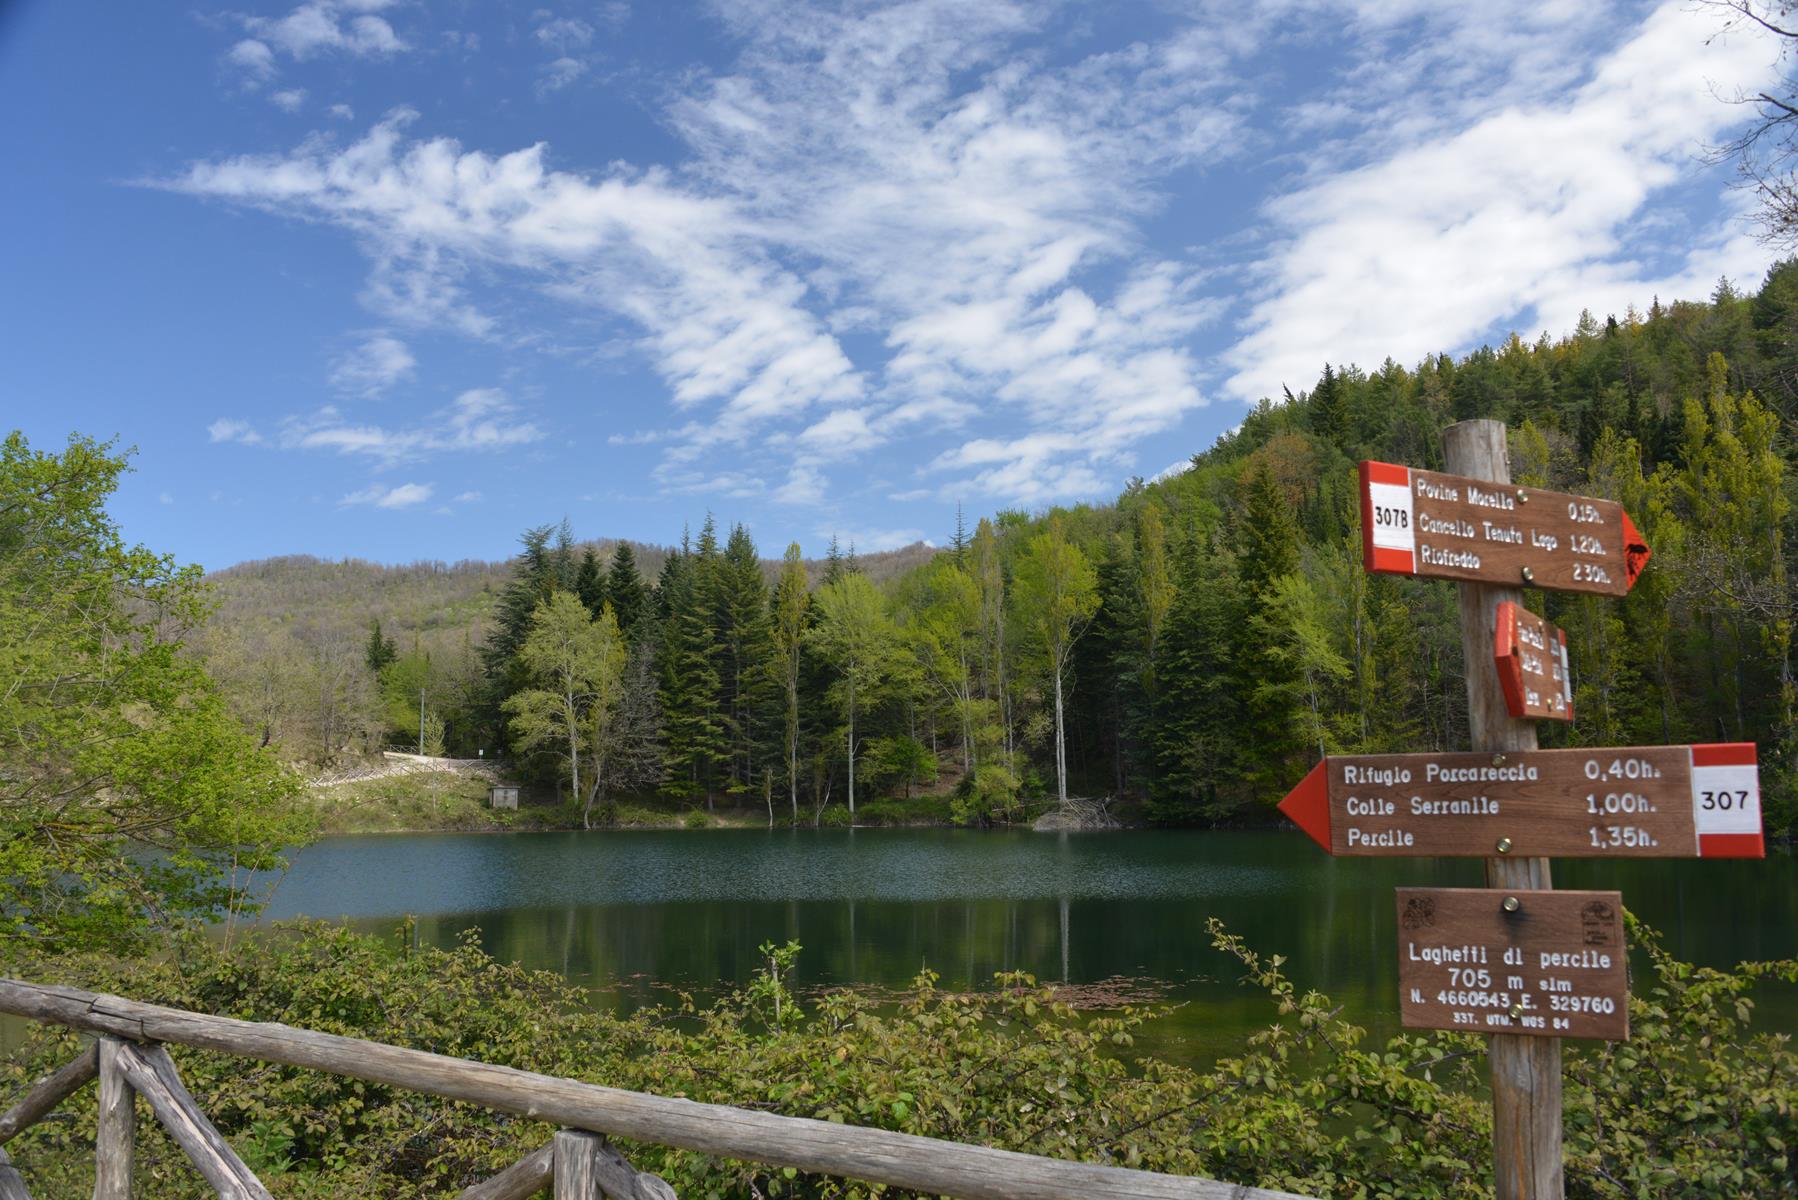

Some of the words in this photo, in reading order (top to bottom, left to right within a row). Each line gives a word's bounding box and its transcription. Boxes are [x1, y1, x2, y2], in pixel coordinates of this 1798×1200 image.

[1467, 486, 1514, 510] Morella
[1375, 506, 1408, 528] 307B
[1419, 512, 1475, 538] Cancello
[1482, 521, 1523, 544] Tenuta
[1421, 544, 1480, 569] Riofreddo
[1344, 765, 1412, 786] Rifugio
[1426, 763, 1538, 782] Porcareccia
[1347, 797, 1395, 815] Colle
[1701, 790, 1749, 810] 307
[1348, 828, 1414, 847] Percile
[1408, 942, 1487, 966] Laghetti
[1503, 947, 1524, 965] di
[1540, 950, 1611, 969] percile
[1448, 967, 1491, 988] 705
[1507, 976, 1523, 989] m
[1410, 988, 1426, 1004] N.
[1437, 990, 1510, 1008] 4660543
[1521, 993, 1537, 1009] E.
[1549, 994, 1614, 1014] 329760
[1521, 1015, 1545, 1028] WGS
[1552, 1016, 1569, 1029] 84
